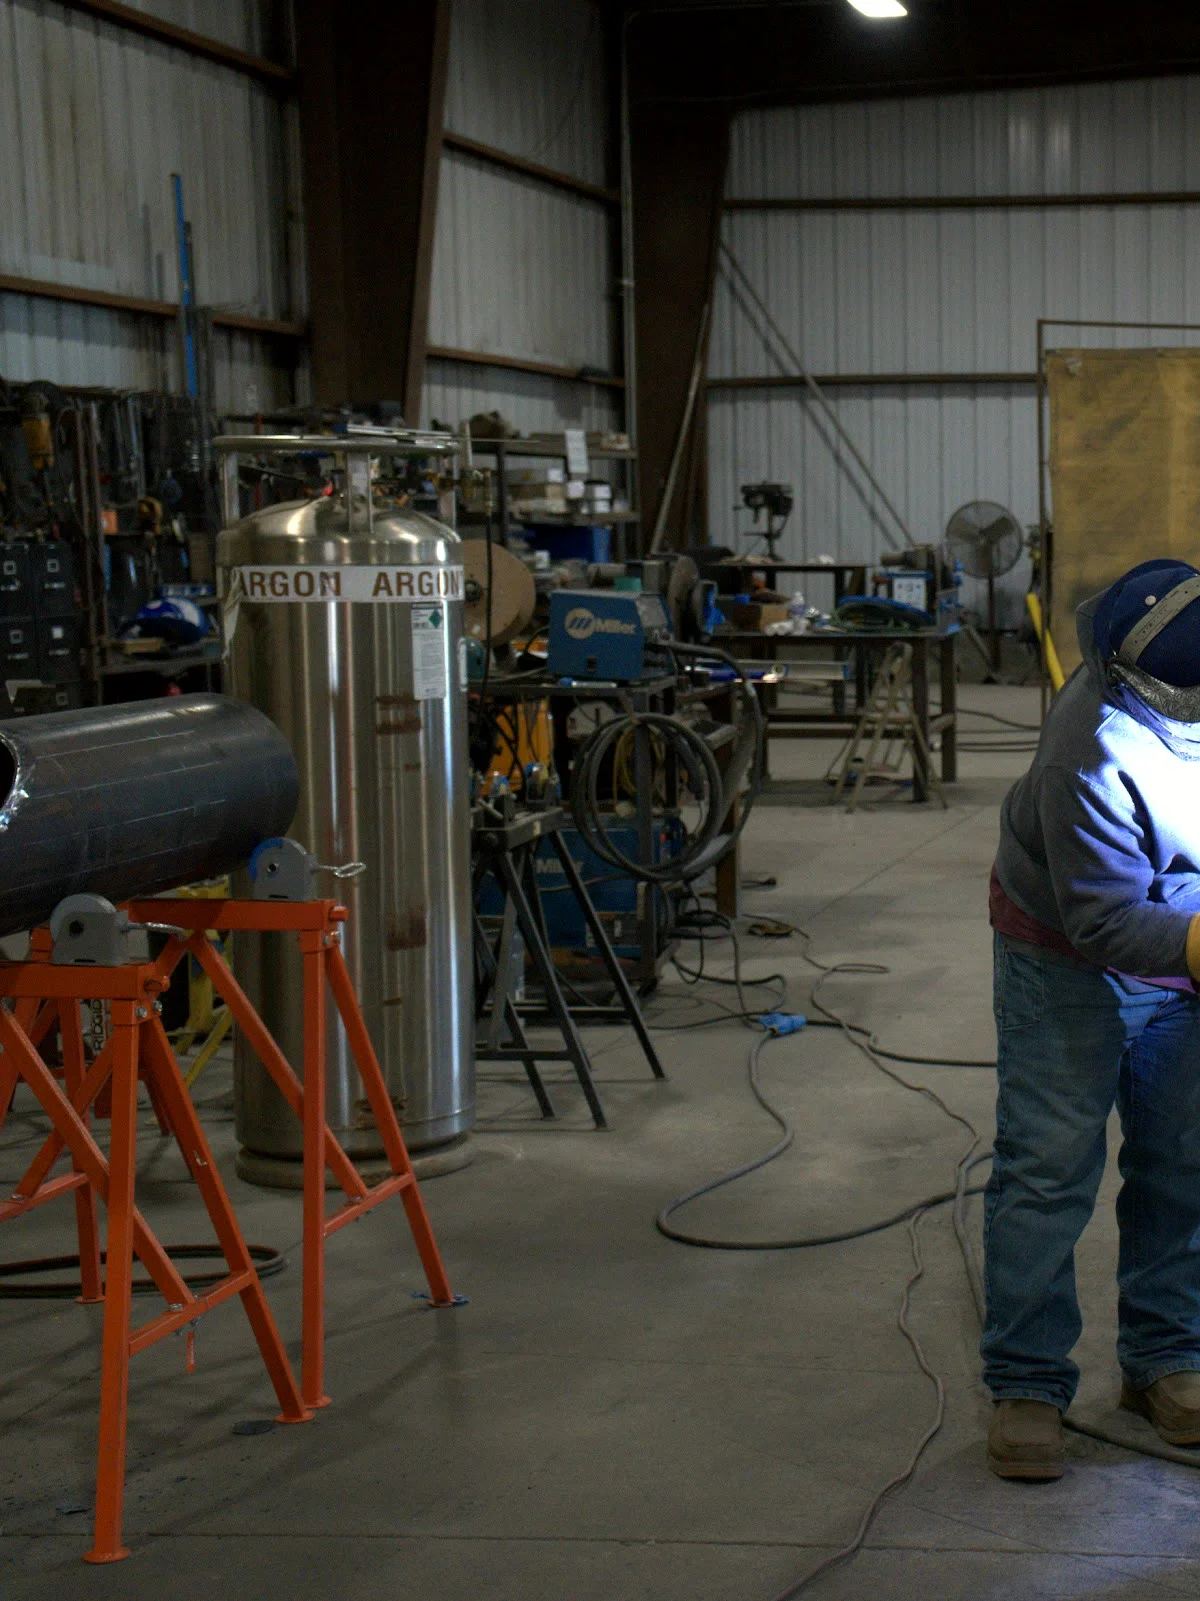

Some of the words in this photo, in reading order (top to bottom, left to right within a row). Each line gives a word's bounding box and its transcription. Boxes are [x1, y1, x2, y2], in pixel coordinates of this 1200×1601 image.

[372, 571, 459, 597] ARGON
[595, 618, 637, 635] Miller
[536, 858, 584, 874] Millr
[93, 999, 104, 1051] RIDGID
